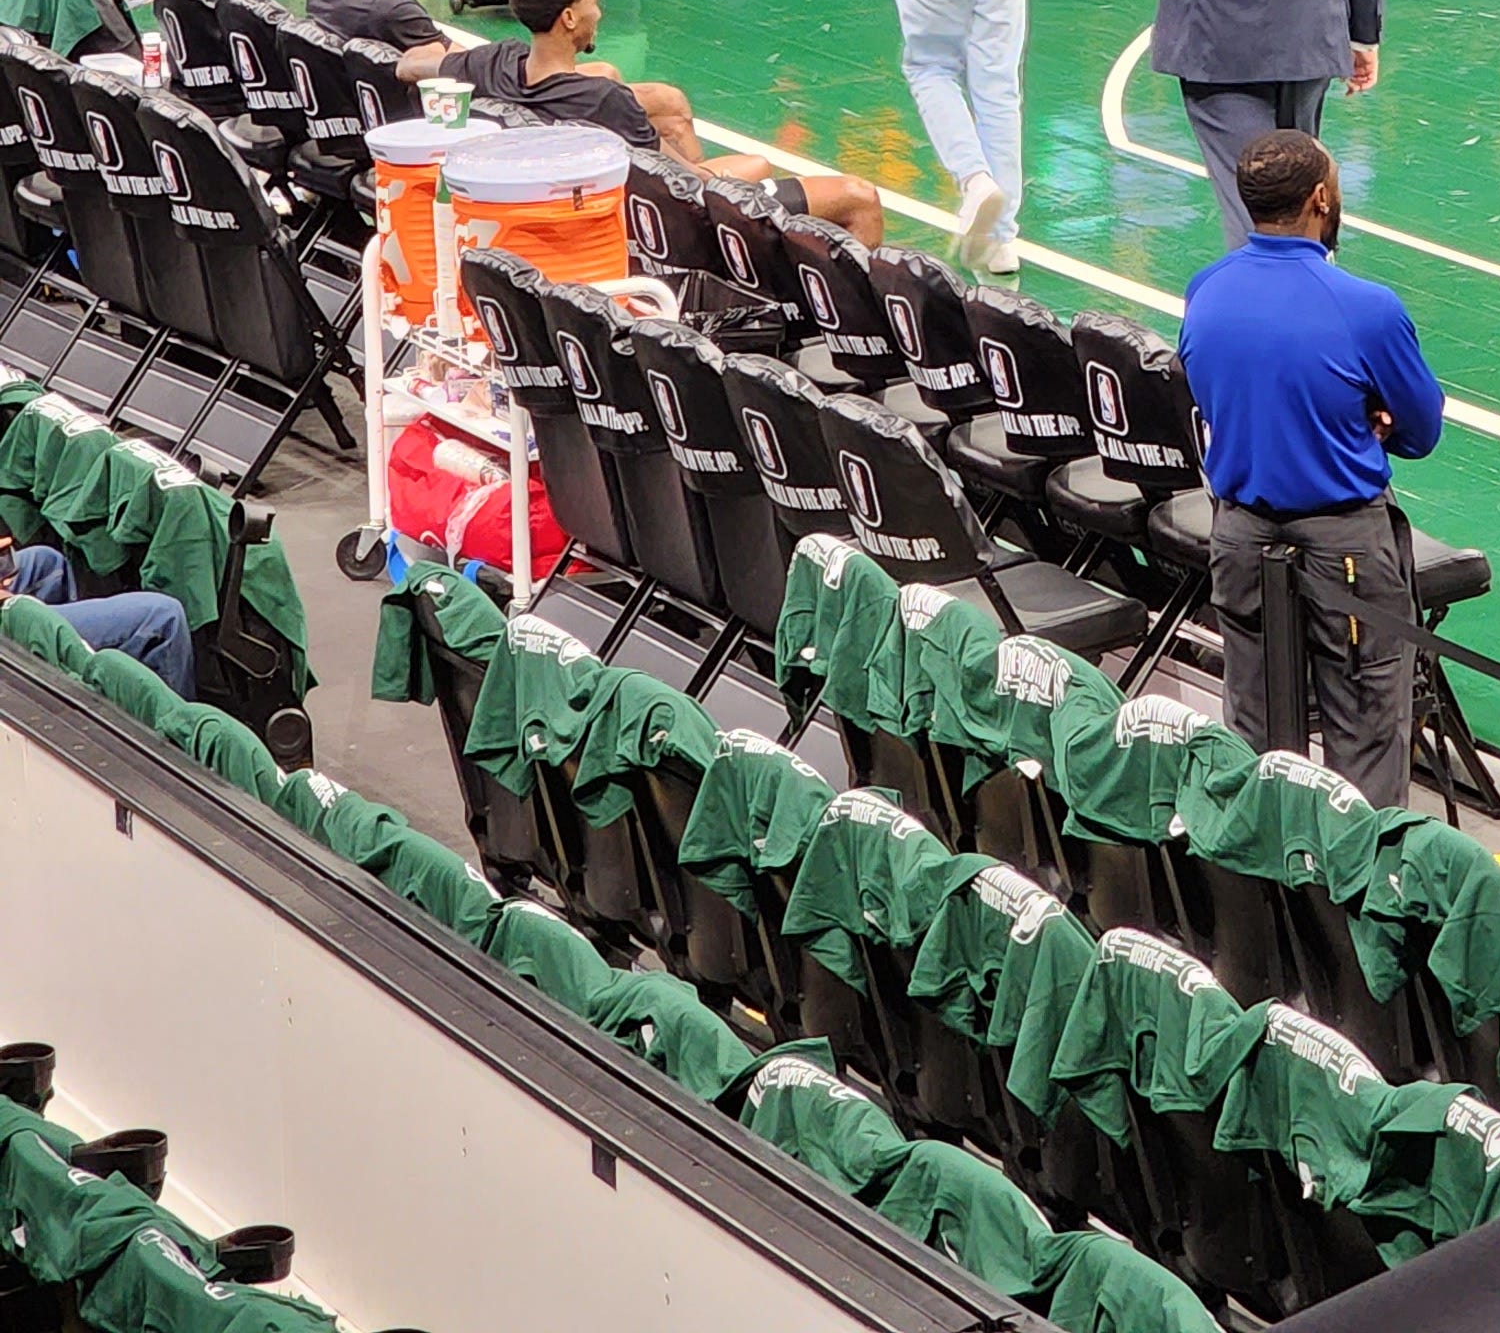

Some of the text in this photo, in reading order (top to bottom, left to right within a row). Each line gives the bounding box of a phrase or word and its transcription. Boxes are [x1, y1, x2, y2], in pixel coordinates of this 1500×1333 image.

[1031, 413, 1058, 437] THE
[1137, 443, 1165, 467] THE
[889, 536, 915, 561] THE
[911, 536, 947, 562] APP.
